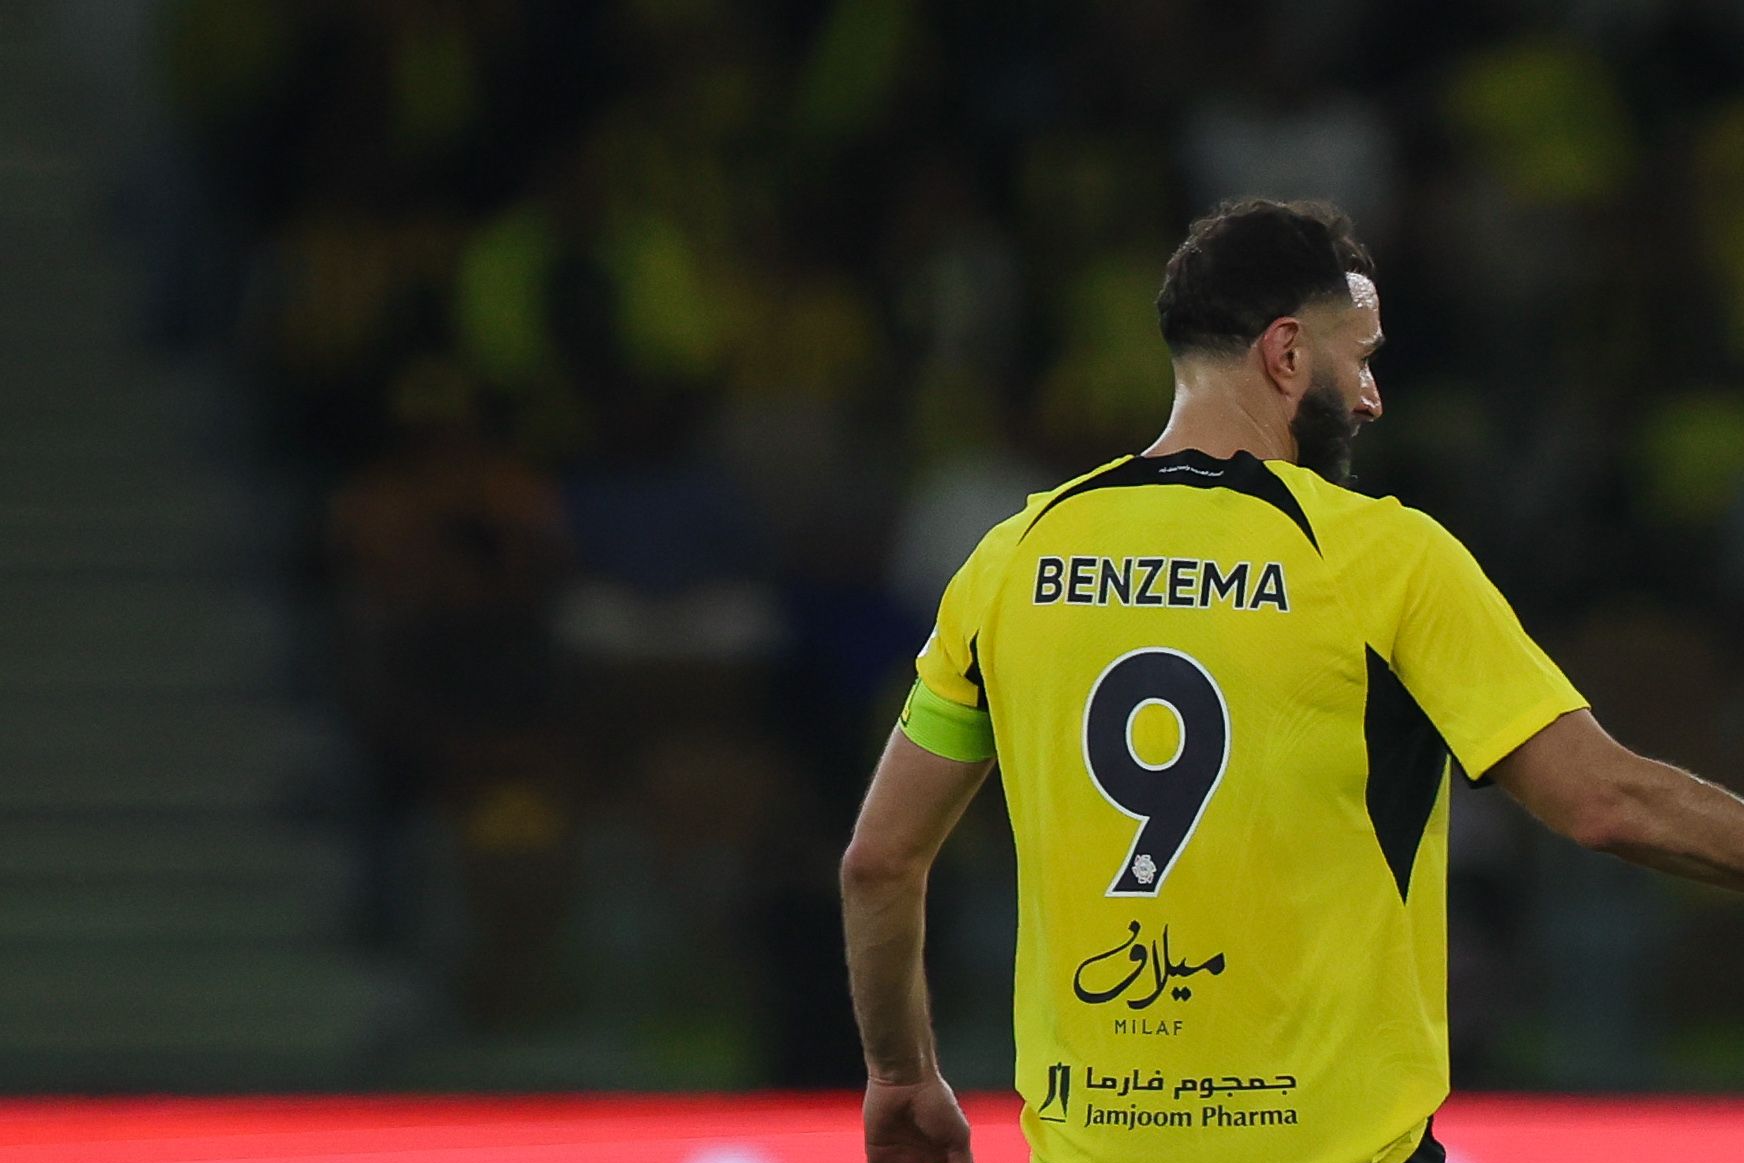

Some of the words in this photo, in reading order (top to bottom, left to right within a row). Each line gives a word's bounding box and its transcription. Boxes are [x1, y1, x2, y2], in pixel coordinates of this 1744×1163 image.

[1033, 555, 1290, 612] BENZEMA
[1081, 646, 1231, 898] 9
[1073, 920, 1225, 1010] ميلاف
[1114, 1018, 1184, 1036] MILAF
[1085, 1066, 1165, 1096] فارما
[1173, 1072, 1298, 1100] جمجوم
[1084, 1103, 1192, 1131] Jamjoom
[1201, 1105, 1298, 1127] Pharma
